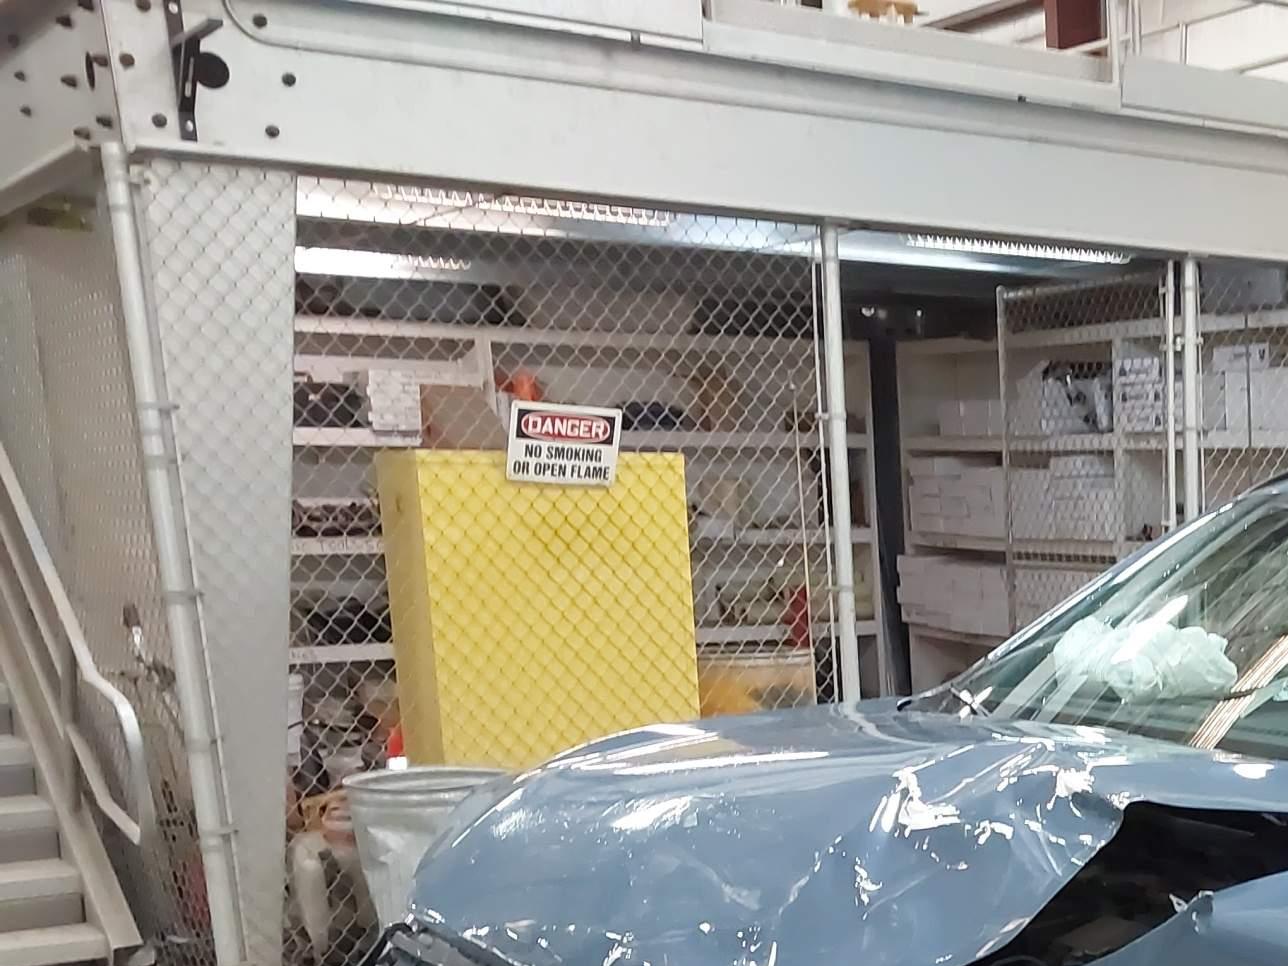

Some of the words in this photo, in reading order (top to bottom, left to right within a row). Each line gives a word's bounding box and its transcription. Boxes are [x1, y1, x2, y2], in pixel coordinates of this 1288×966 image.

[528, 416, 605, 439] DANGER
[524, 443, 543, 459] NO
[546, 446, 602, 462] SMOKING
[513, 461, 530, 475] OR
[534, 462, 567, 478] OPEN
[570, 465, 610, 481] FLAME
